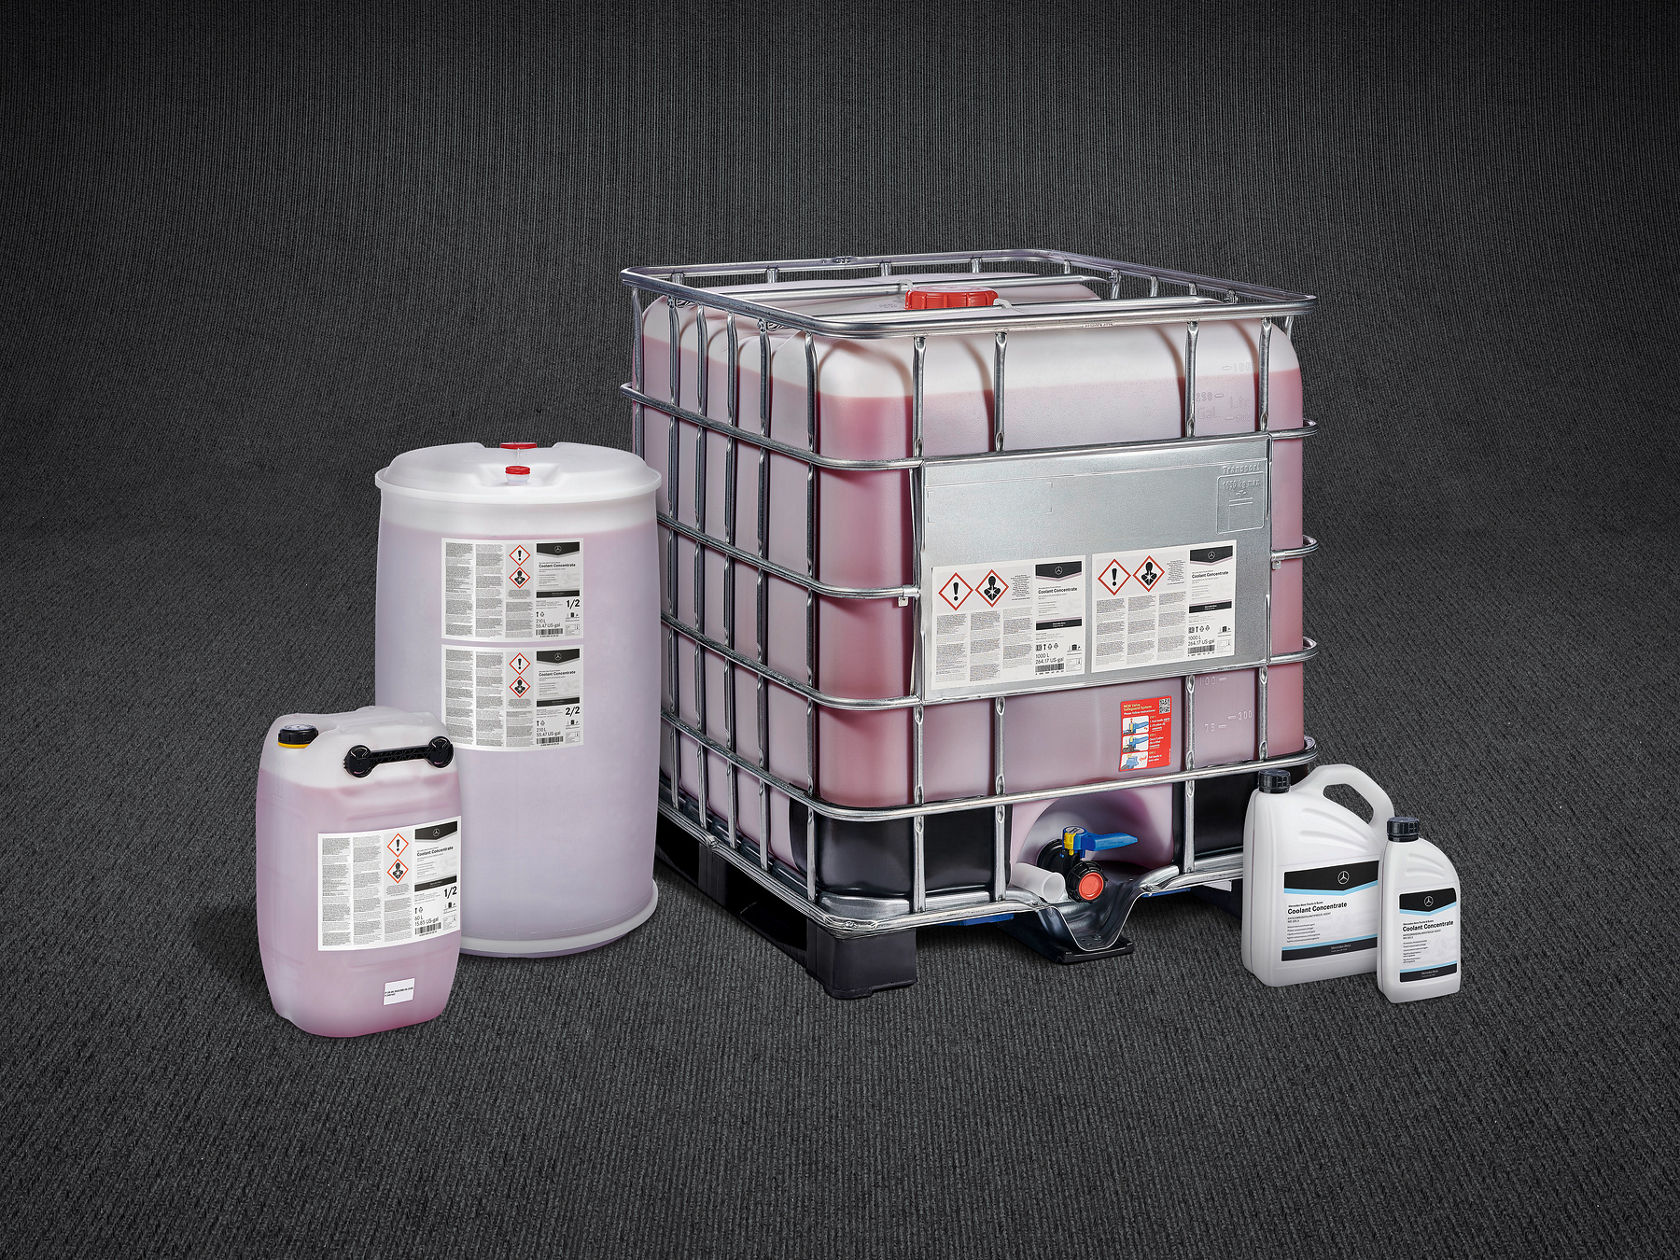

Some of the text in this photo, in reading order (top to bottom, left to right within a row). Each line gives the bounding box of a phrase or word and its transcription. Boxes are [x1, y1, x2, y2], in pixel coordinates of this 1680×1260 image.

[566, 599, 580, 610] 1/2
[565, 706, 580, 717] 2/2
[444, 886, 458, 900] 1/2
[1312, 902, 1347, 911] Concentrate
[1424, 921, 1453, 929] Concentrate
